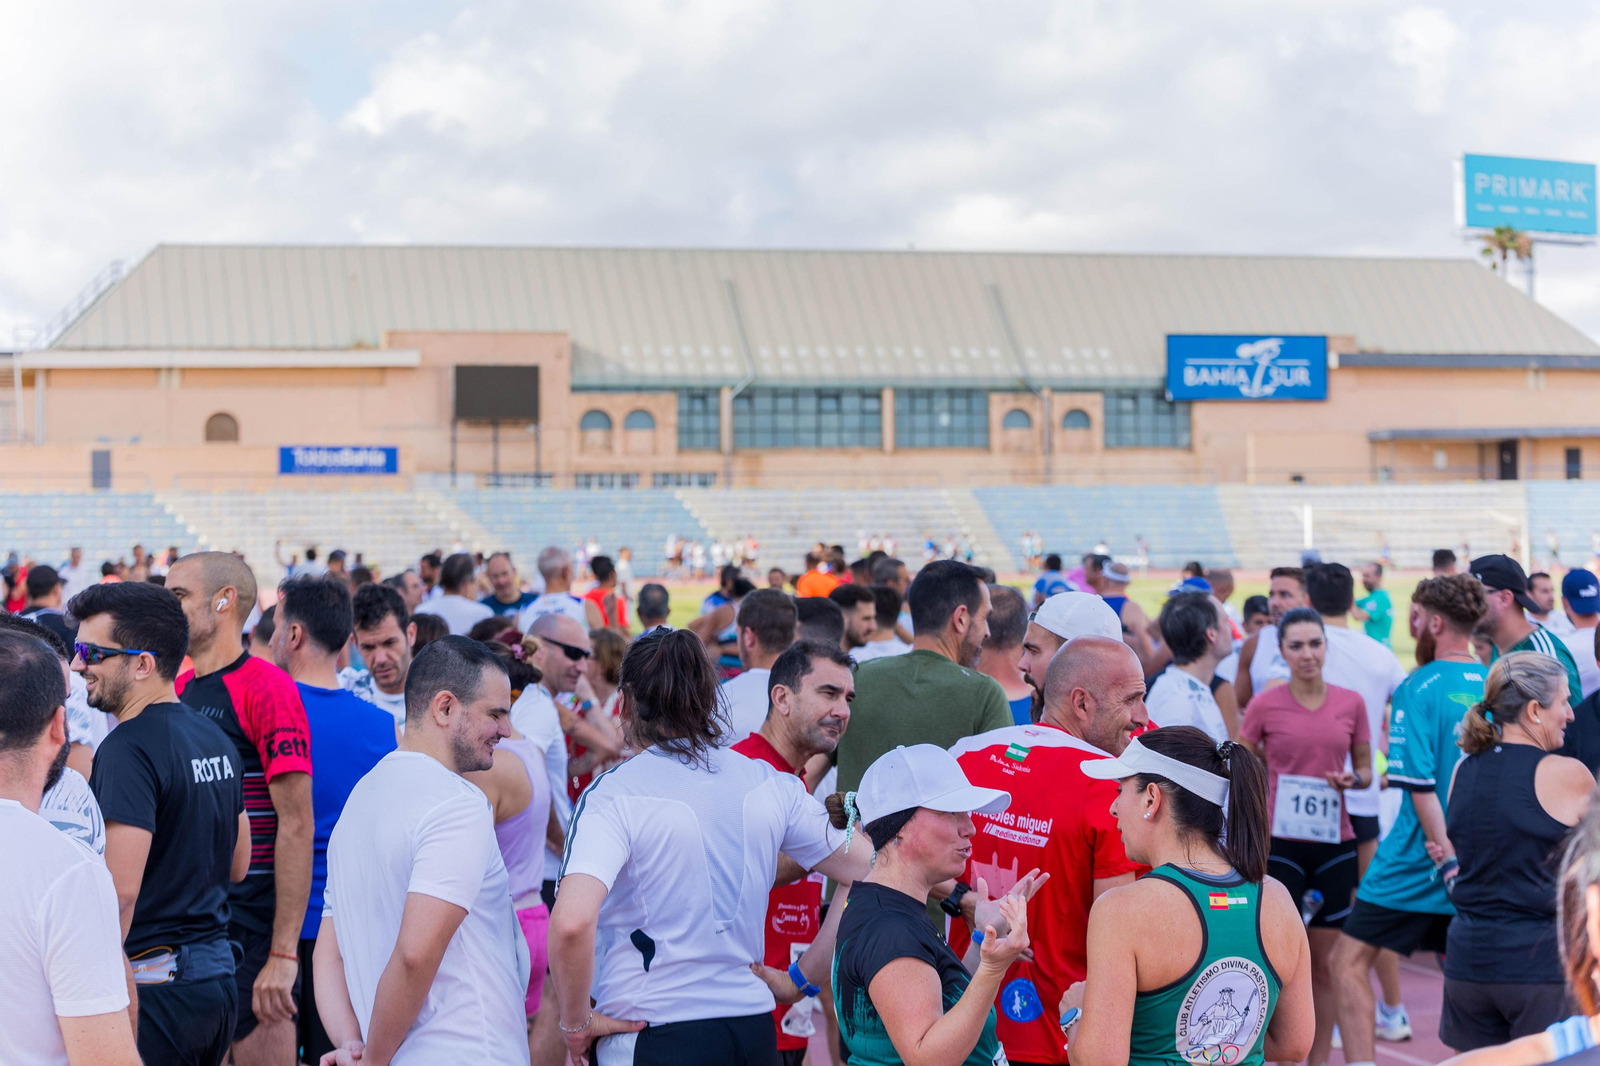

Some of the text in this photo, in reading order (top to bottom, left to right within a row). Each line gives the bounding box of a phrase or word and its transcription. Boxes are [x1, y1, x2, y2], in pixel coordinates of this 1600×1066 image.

[1474, 173, 1590, 203] PRIMARK
[1268, 366, 1311, 387] SUR
[191, 755, 234, 783] ROTA
[1291, 794, 1328, 818] 161
[1017, 813, 1053, 835] miguel
[1017, 833, 1041, 845] sidonia
[1179, 1012, 1188, 1037] CLUB
[1186, 965, 1220, 1011] ATLETISMO
[1221, 960, 1249, 970] DIVINA
[1249, 967, 1268, 1005] PASTORA
